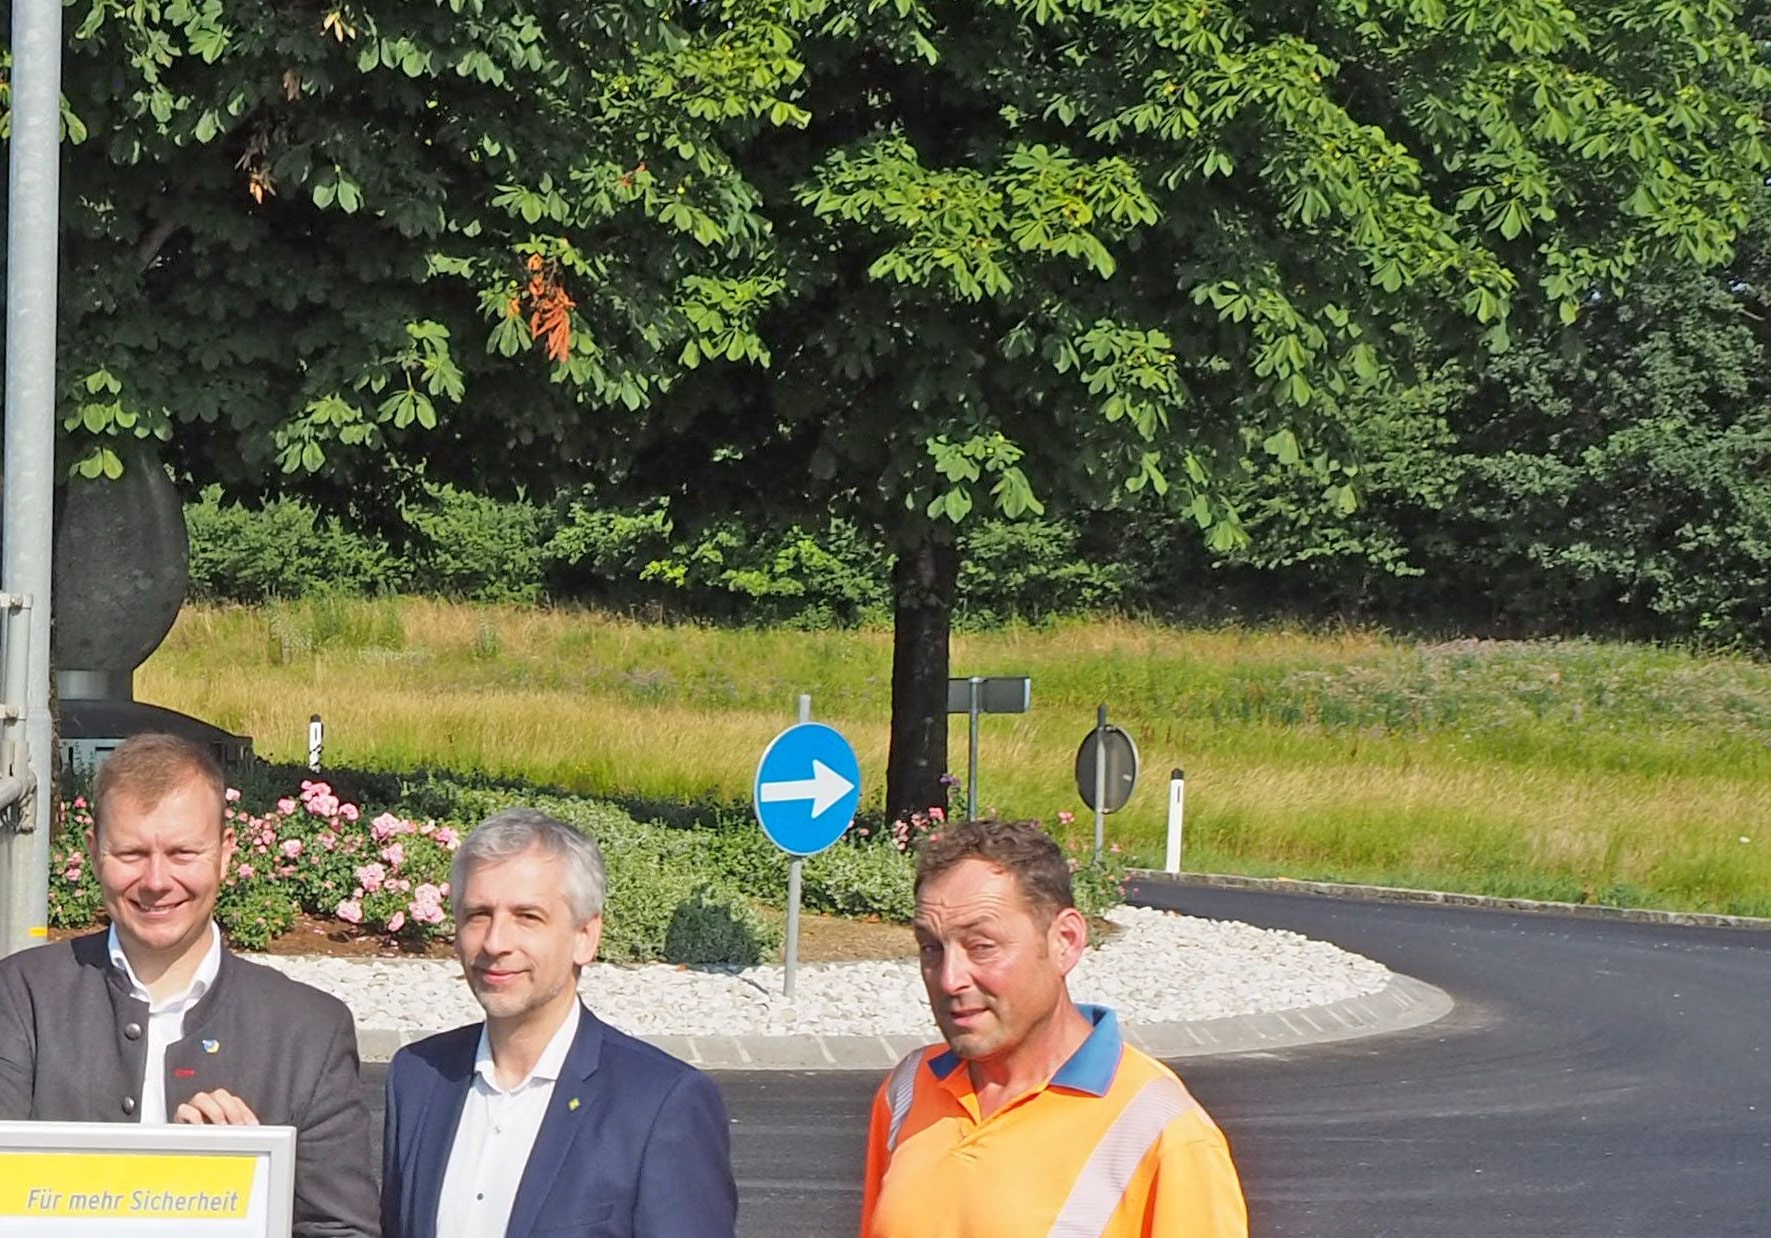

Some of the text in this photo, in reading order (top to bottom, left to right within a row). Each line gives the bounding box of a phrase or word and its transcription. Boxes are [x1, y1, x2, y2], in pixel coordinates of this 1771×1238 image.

[27, 1188, 239, 1212] Für mehr Sicherheit
